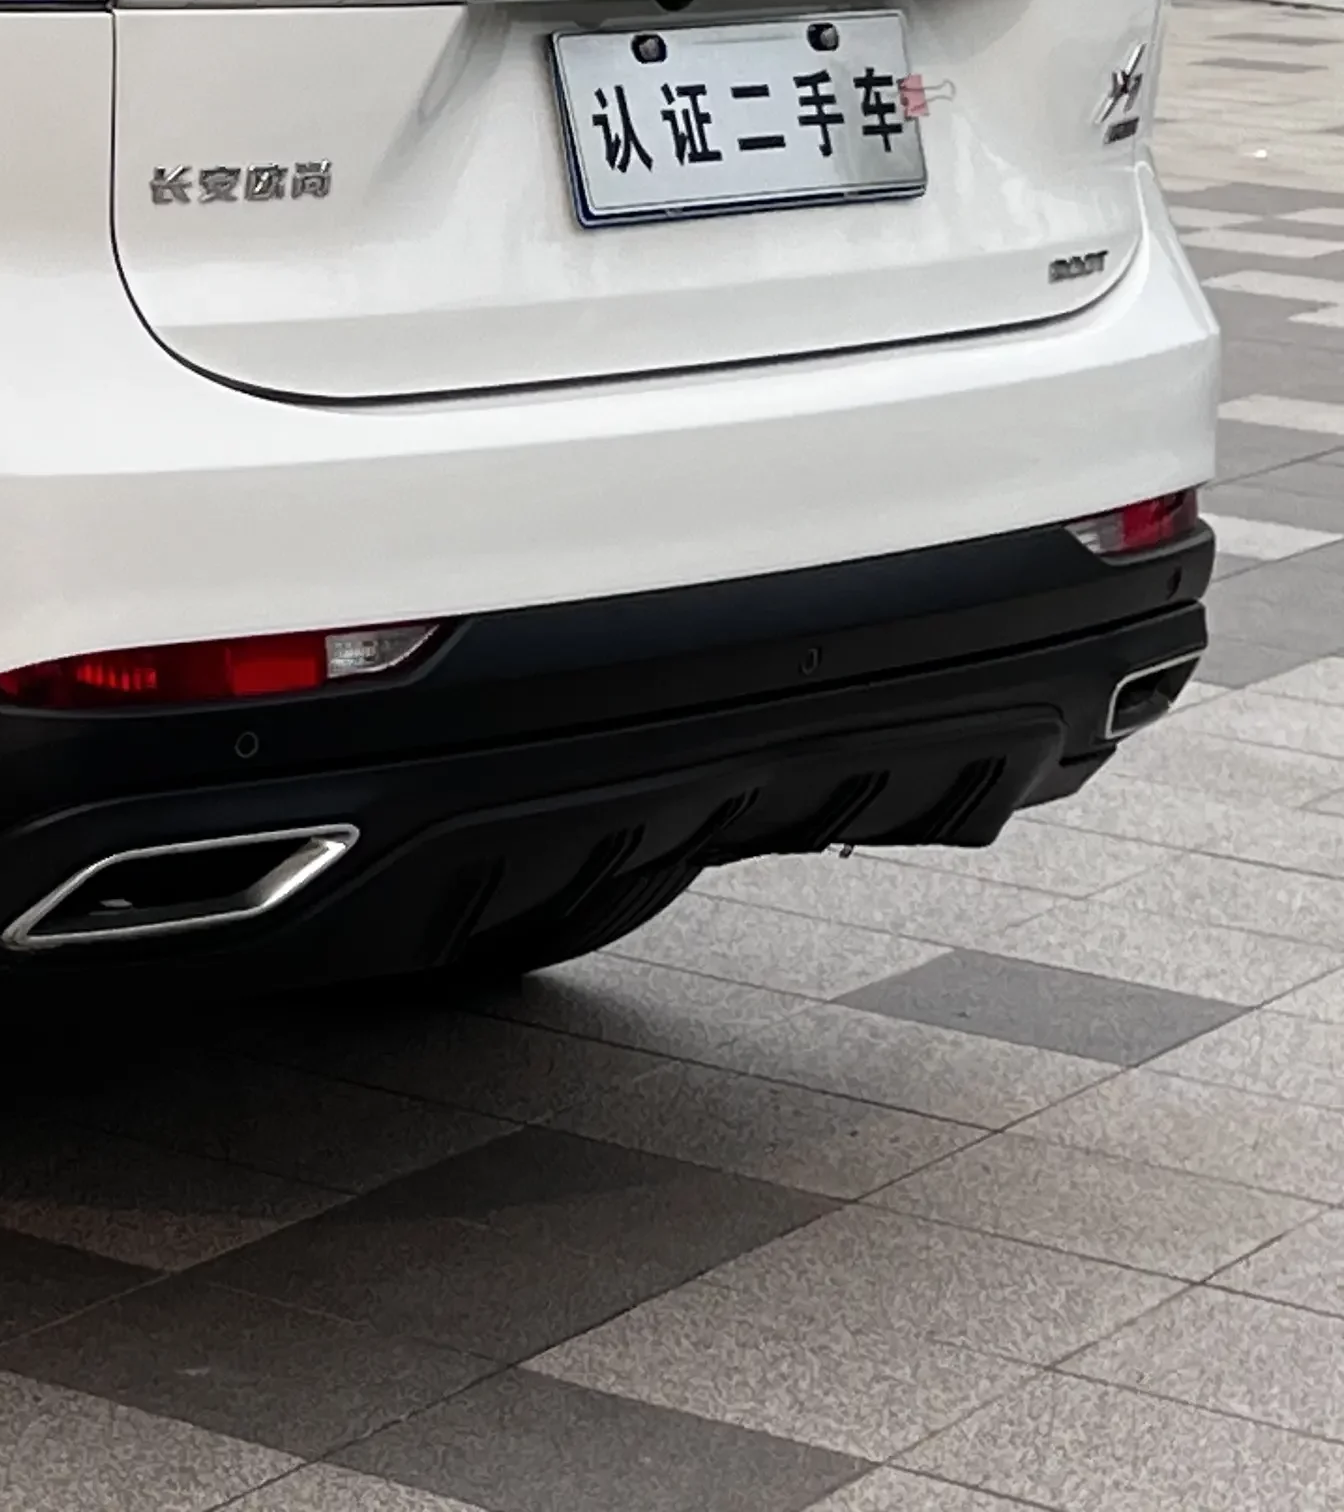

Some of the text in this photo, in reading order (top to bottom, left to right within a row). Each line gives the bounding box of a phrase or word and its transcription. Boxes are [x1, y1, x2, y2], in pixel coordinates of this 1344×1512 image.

[592, 67, 904, 174] 认证二手车
[149, 159, 332, 206] 长安欧尚
